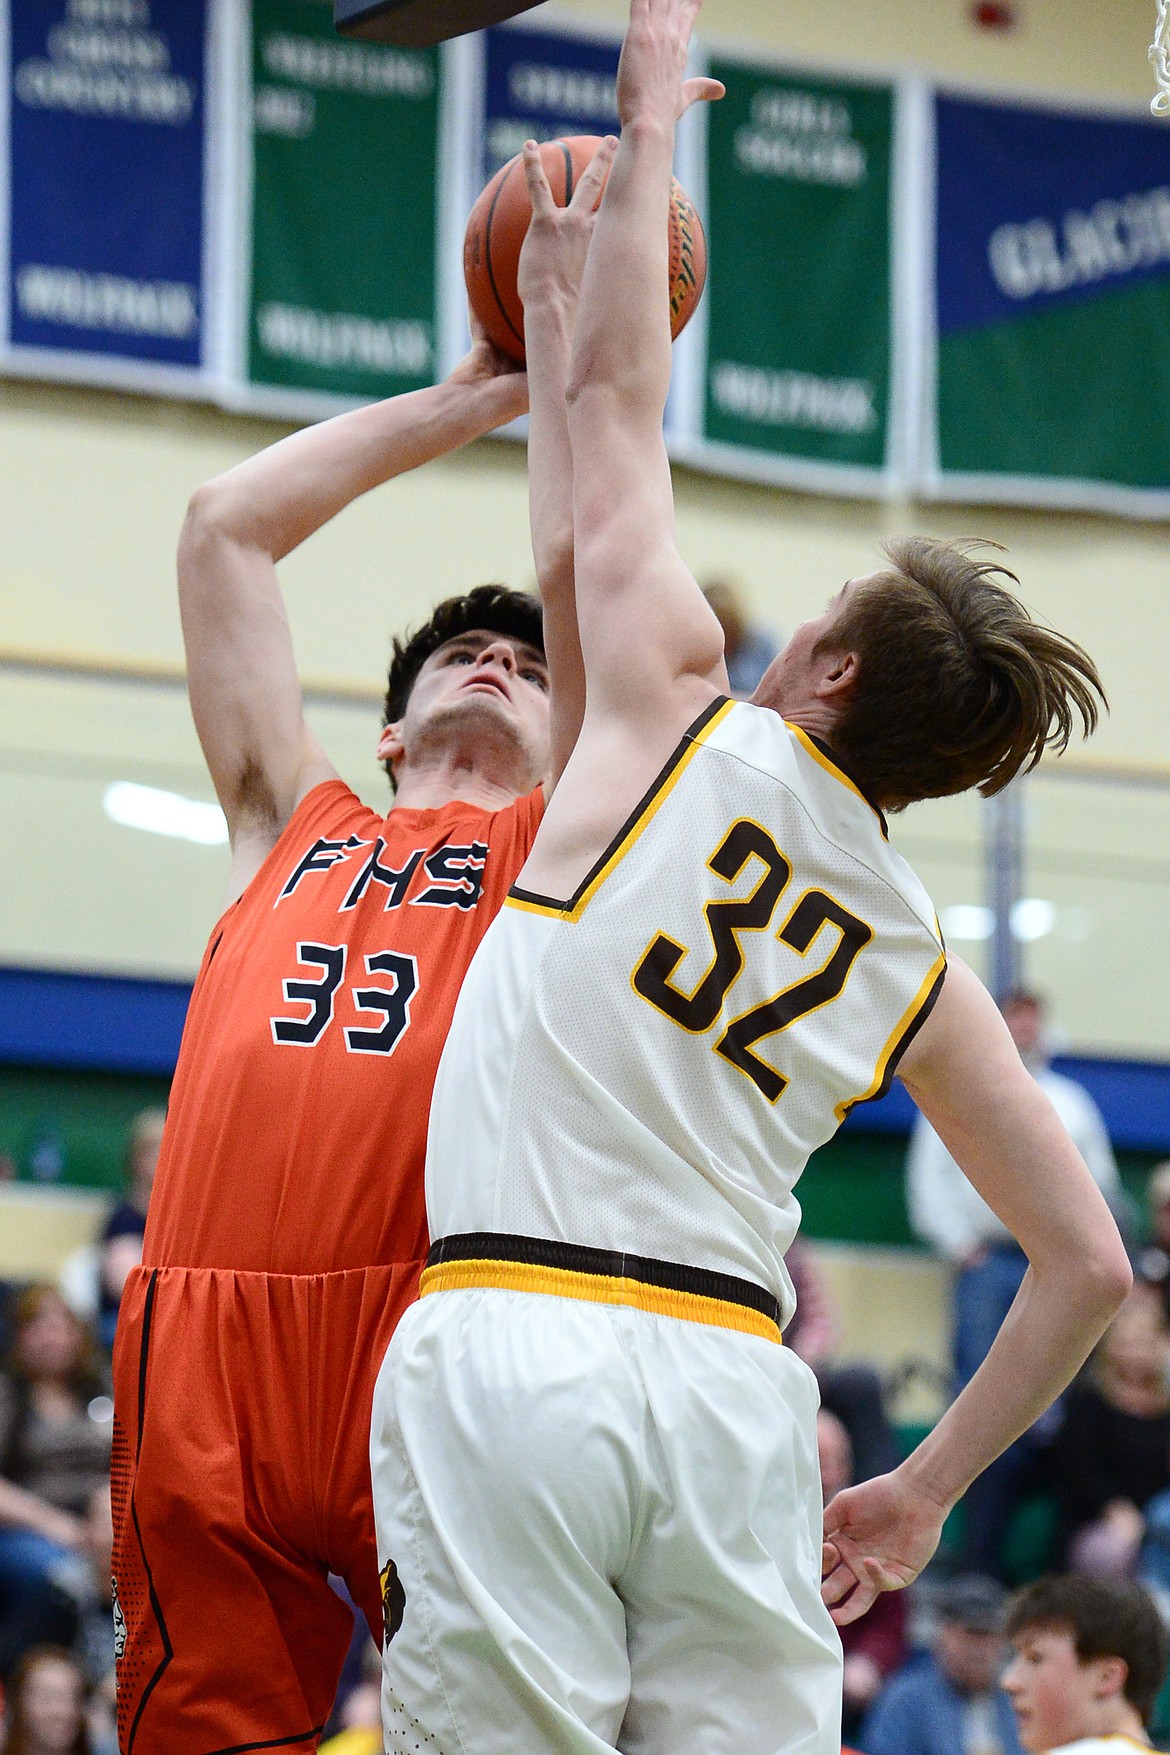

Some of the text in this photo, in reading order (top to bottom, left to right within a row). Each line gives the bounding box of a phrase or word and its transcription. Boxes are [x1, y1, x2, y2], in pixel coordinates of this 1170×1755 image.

[272, 833, 490, 913] FHS
[269, 941, 420, 1057] 33
[629, 816, 875, 1107] 32
